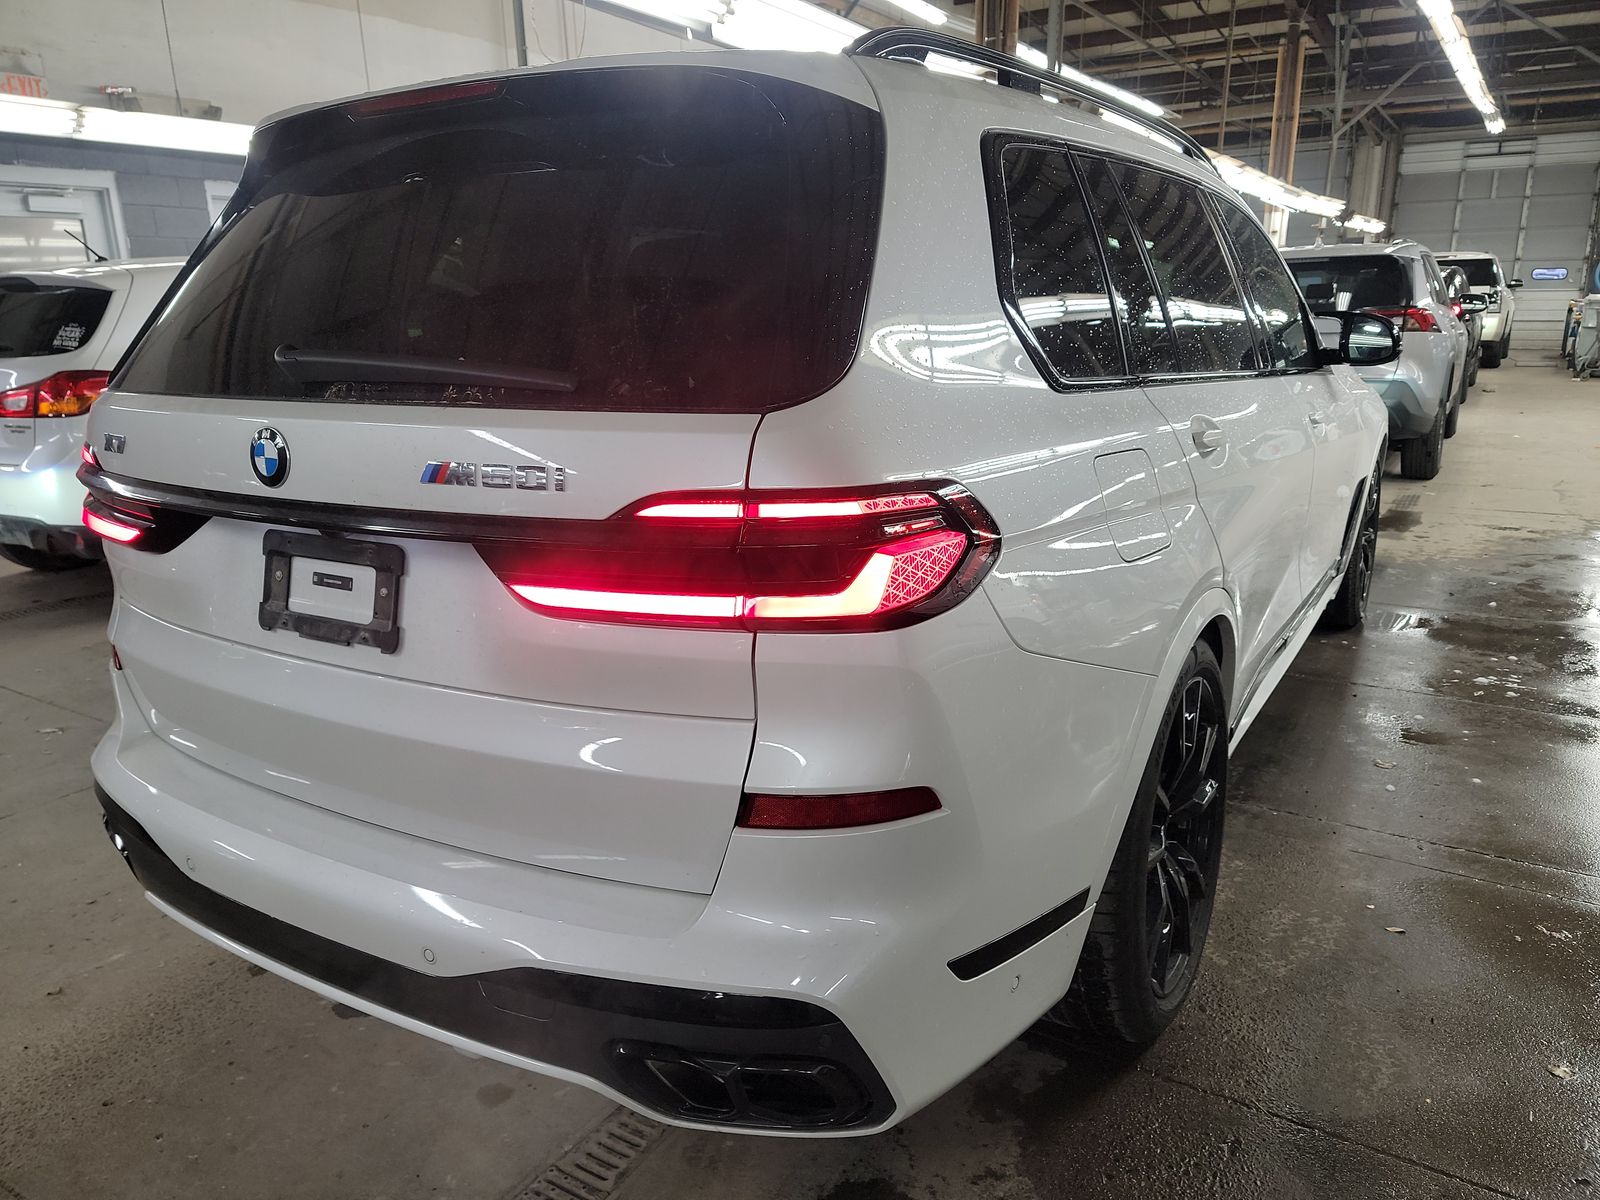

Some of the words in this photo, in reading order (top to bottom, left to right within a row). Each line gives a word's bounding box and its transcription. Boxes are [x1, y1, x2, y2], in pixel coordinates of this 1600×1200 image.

[7, 75, 42, 98] EXIT
[103, 432, 126, 454] X7
[252, 429, 285, 449] BMW
